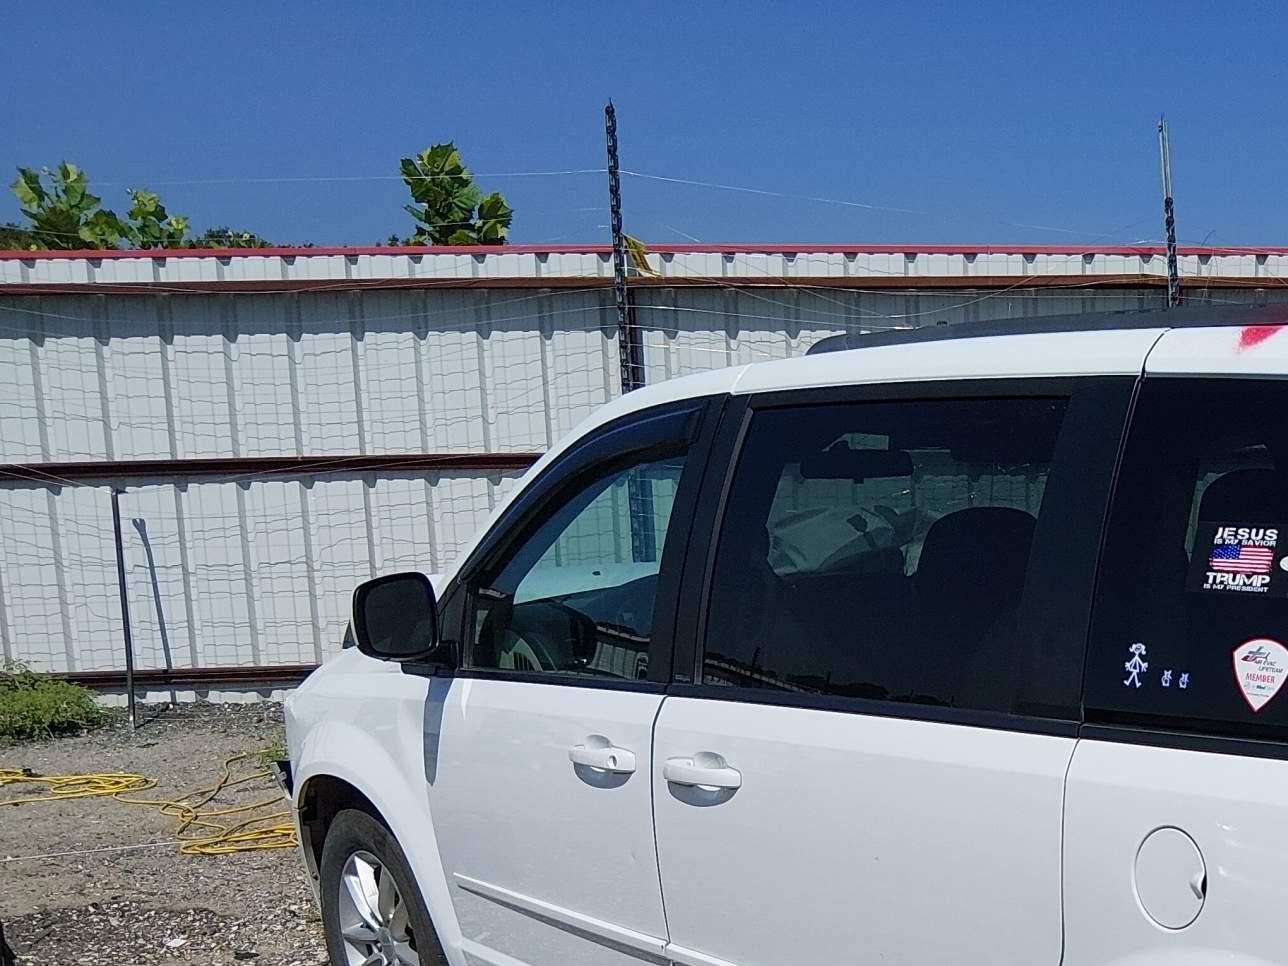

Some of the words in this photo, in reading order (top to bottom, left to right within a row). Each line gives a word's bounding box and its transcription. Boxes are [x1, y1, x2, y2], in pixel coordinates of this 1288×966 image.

[1214, 527, 1278, 540] JESUS
[1241, 539, 1277, 547] SAVIOR
[1206, 572, 1271, 586] TRUMP
[1226, 584, 1270, 592] PRESIDENT
[1245, 672, 1275, 683] MEMBER
